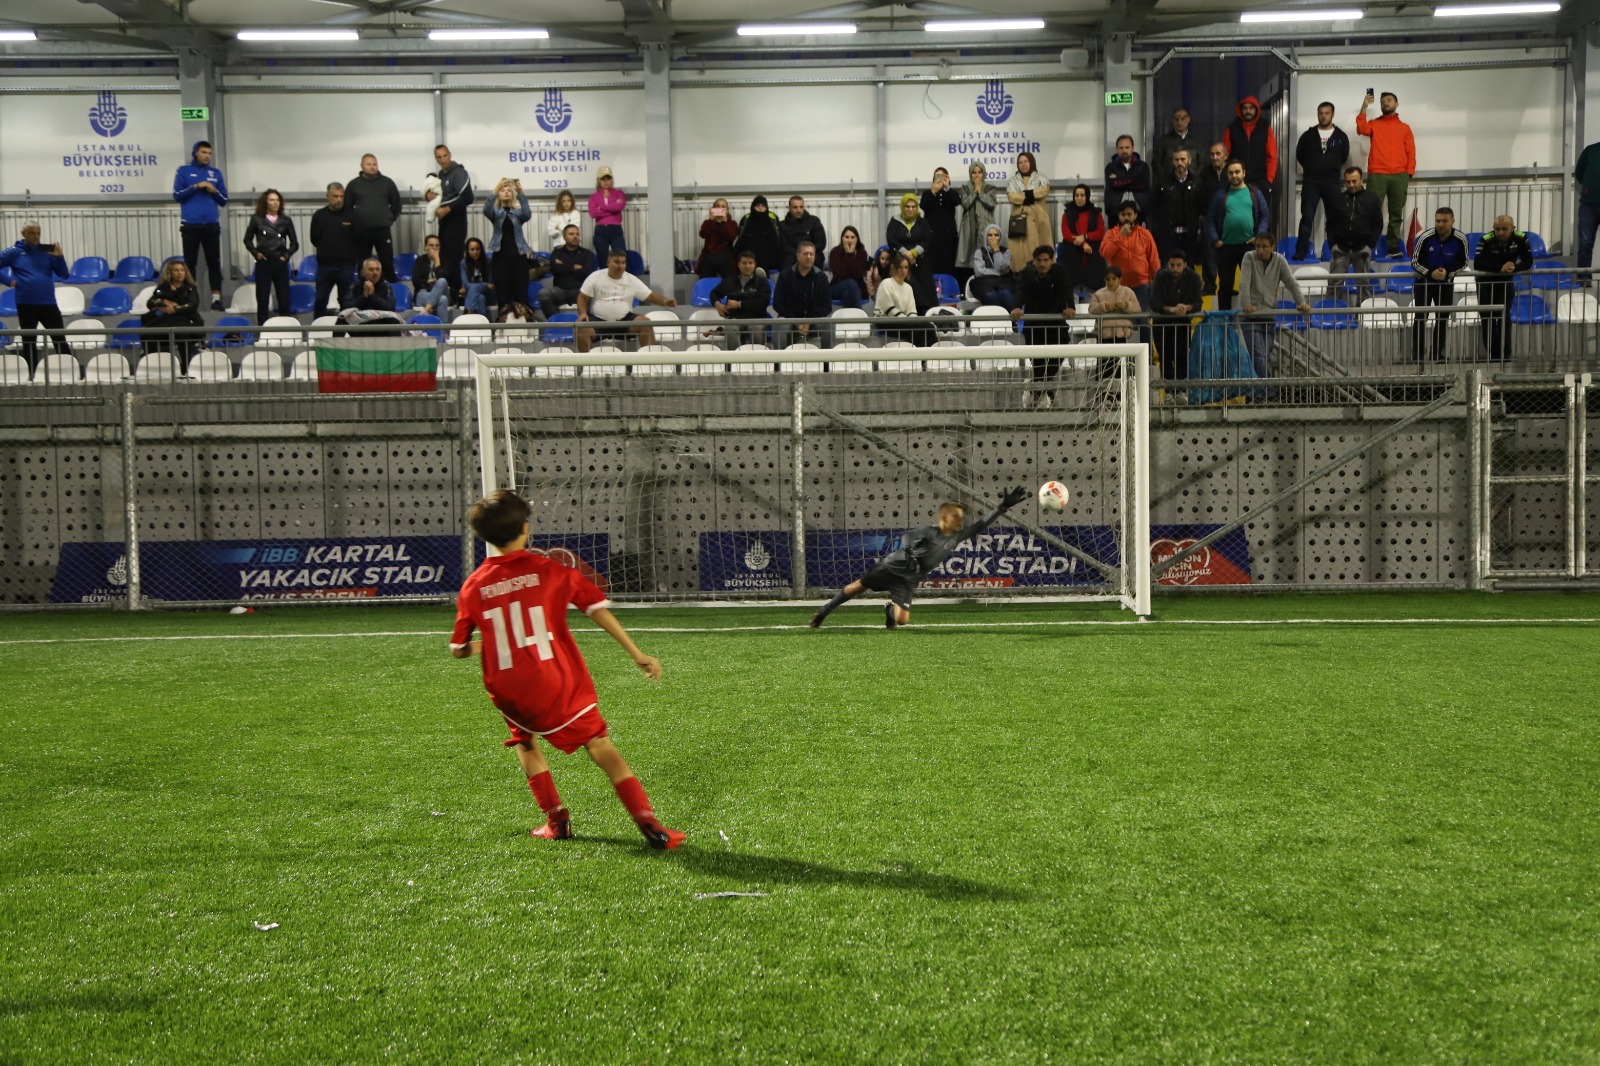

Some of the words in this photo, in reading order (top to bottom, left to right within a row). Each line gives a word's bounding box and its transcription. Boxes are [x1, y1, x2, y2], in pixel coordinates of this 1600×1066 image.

[963, 131, 1026, 139] İSTANBUL
[77, 143, 143, 152] İSTANBUL
[522, 138, 586, 147] İSTANBUL
[63, 154, 158, 169] BÜYÜKŞEHİR
[509, 148, 601, 163] BÜYÜKŞEHİR
[79, 169, 144, 178] BELEDİYESİ
[524, 164, 588, 173] BELEDİYESİ
[100, 184, 125, 193] 2023
[544, 180, 569, 188] 2023
[953, 533, 1043, 552] ARTAL
[304, 543, 411, 564] KARTAL
[996, 556, 1077, 575] STADI
[238, 567, 358, 588] YAKACIK
[361, 565, 445, 585] STADI
[482, 600, 555, 671] 14
